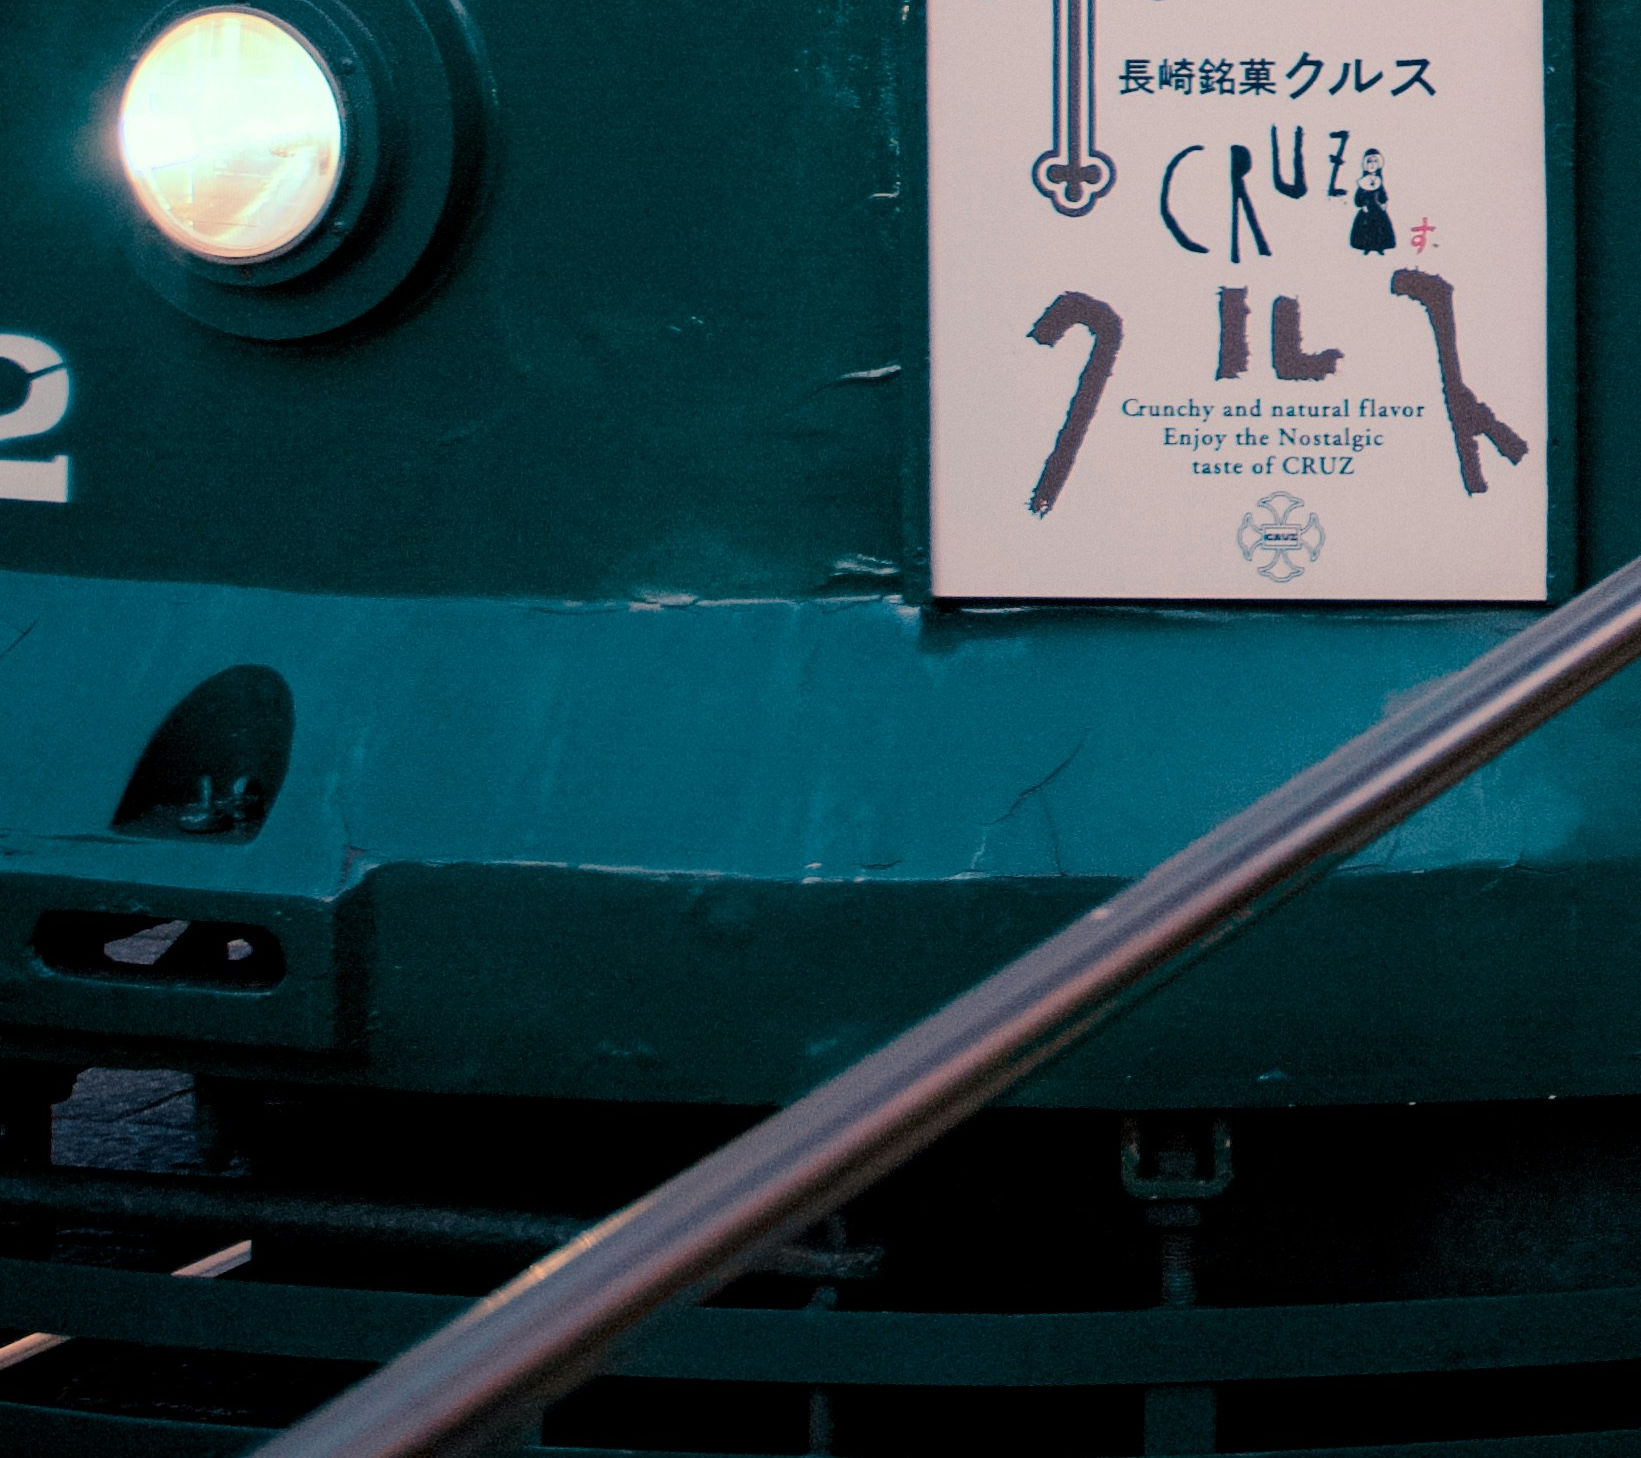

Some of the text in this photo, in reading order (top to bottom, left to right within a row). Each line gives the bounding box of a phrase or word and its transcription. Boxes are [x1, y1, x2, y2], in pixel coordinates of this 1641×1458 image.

[1118, 51, 1437, 101] 長崎銘菓クルス
[1160, 123, 1351, 264] CRUZ
[1121, 398, 1425, 422] Crunchy and natural flavor
[1163, 427, 1385, 452] Enjoy the Nostalgic
[1192, 456, 1356, 476] taste of CRUZ
